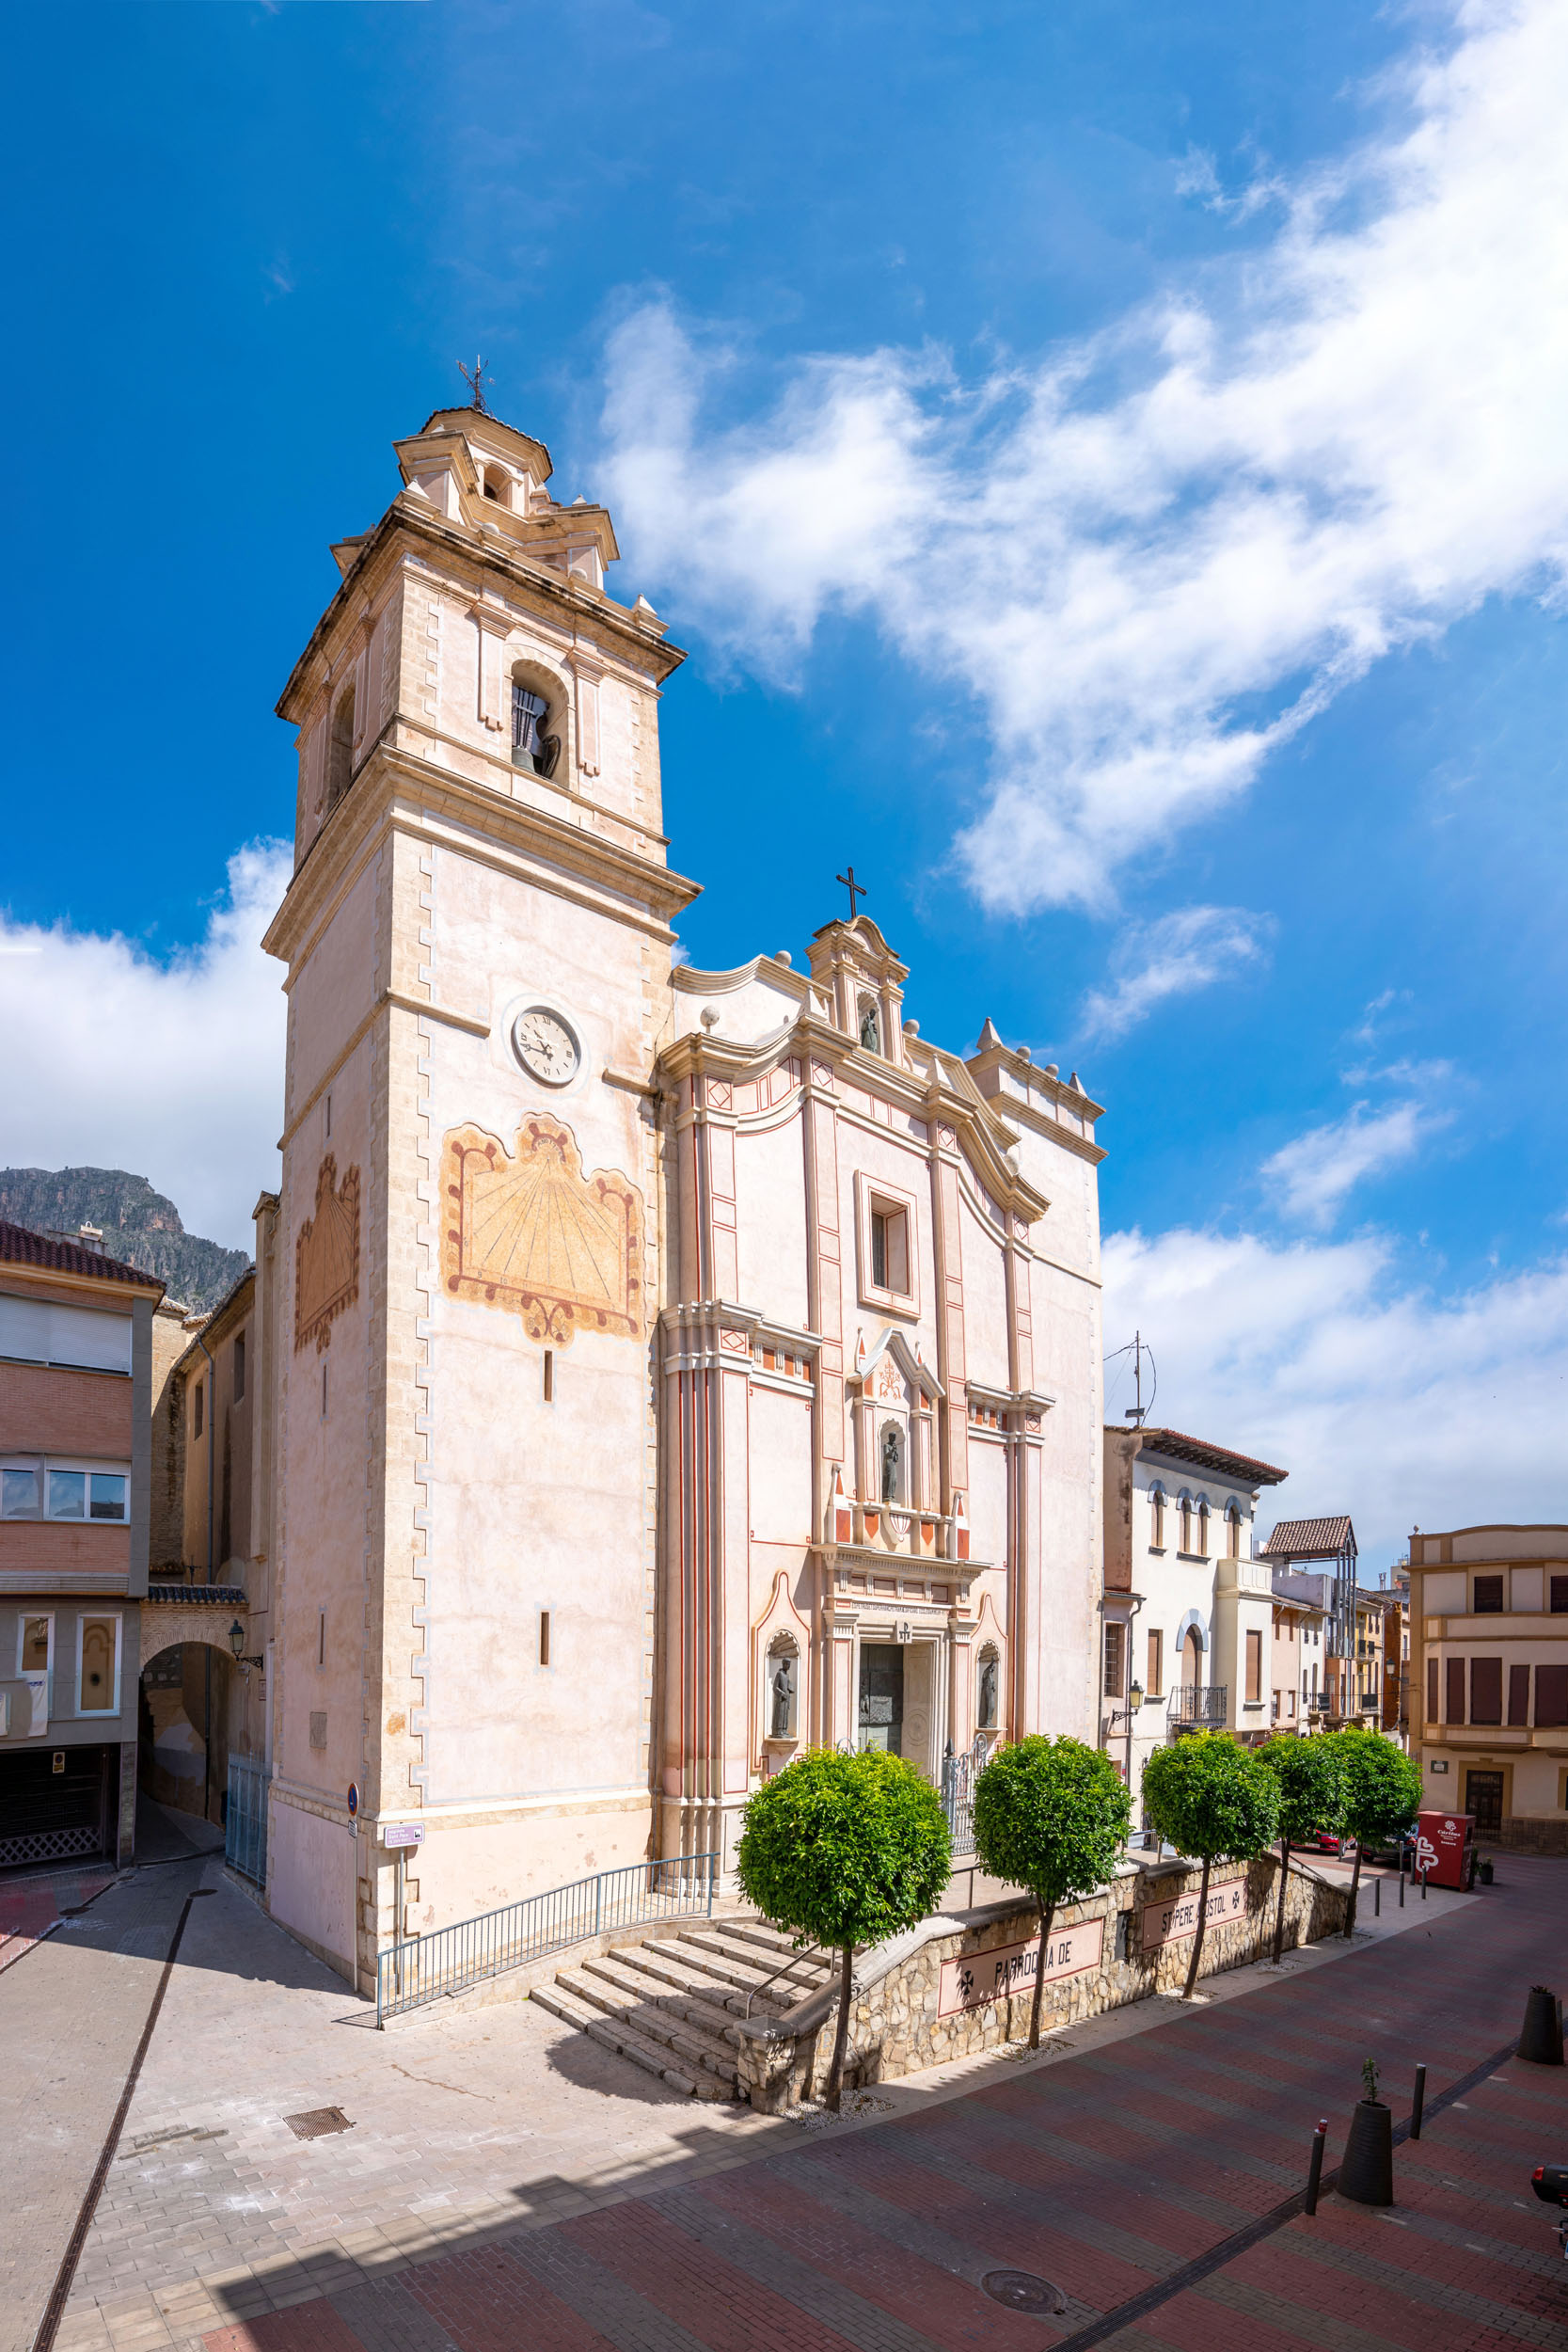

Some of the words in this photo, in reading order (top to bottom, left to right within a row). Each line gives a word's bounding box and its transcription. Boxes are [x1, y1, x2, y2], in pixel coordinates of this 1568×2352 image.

[543, 1016, 551, 1025] XII
[543, 1066, 551, 1075] VI
[994, 1946, 1053, 1986] PARROQIA
[1058, 1941, 1072, 1964] DE
